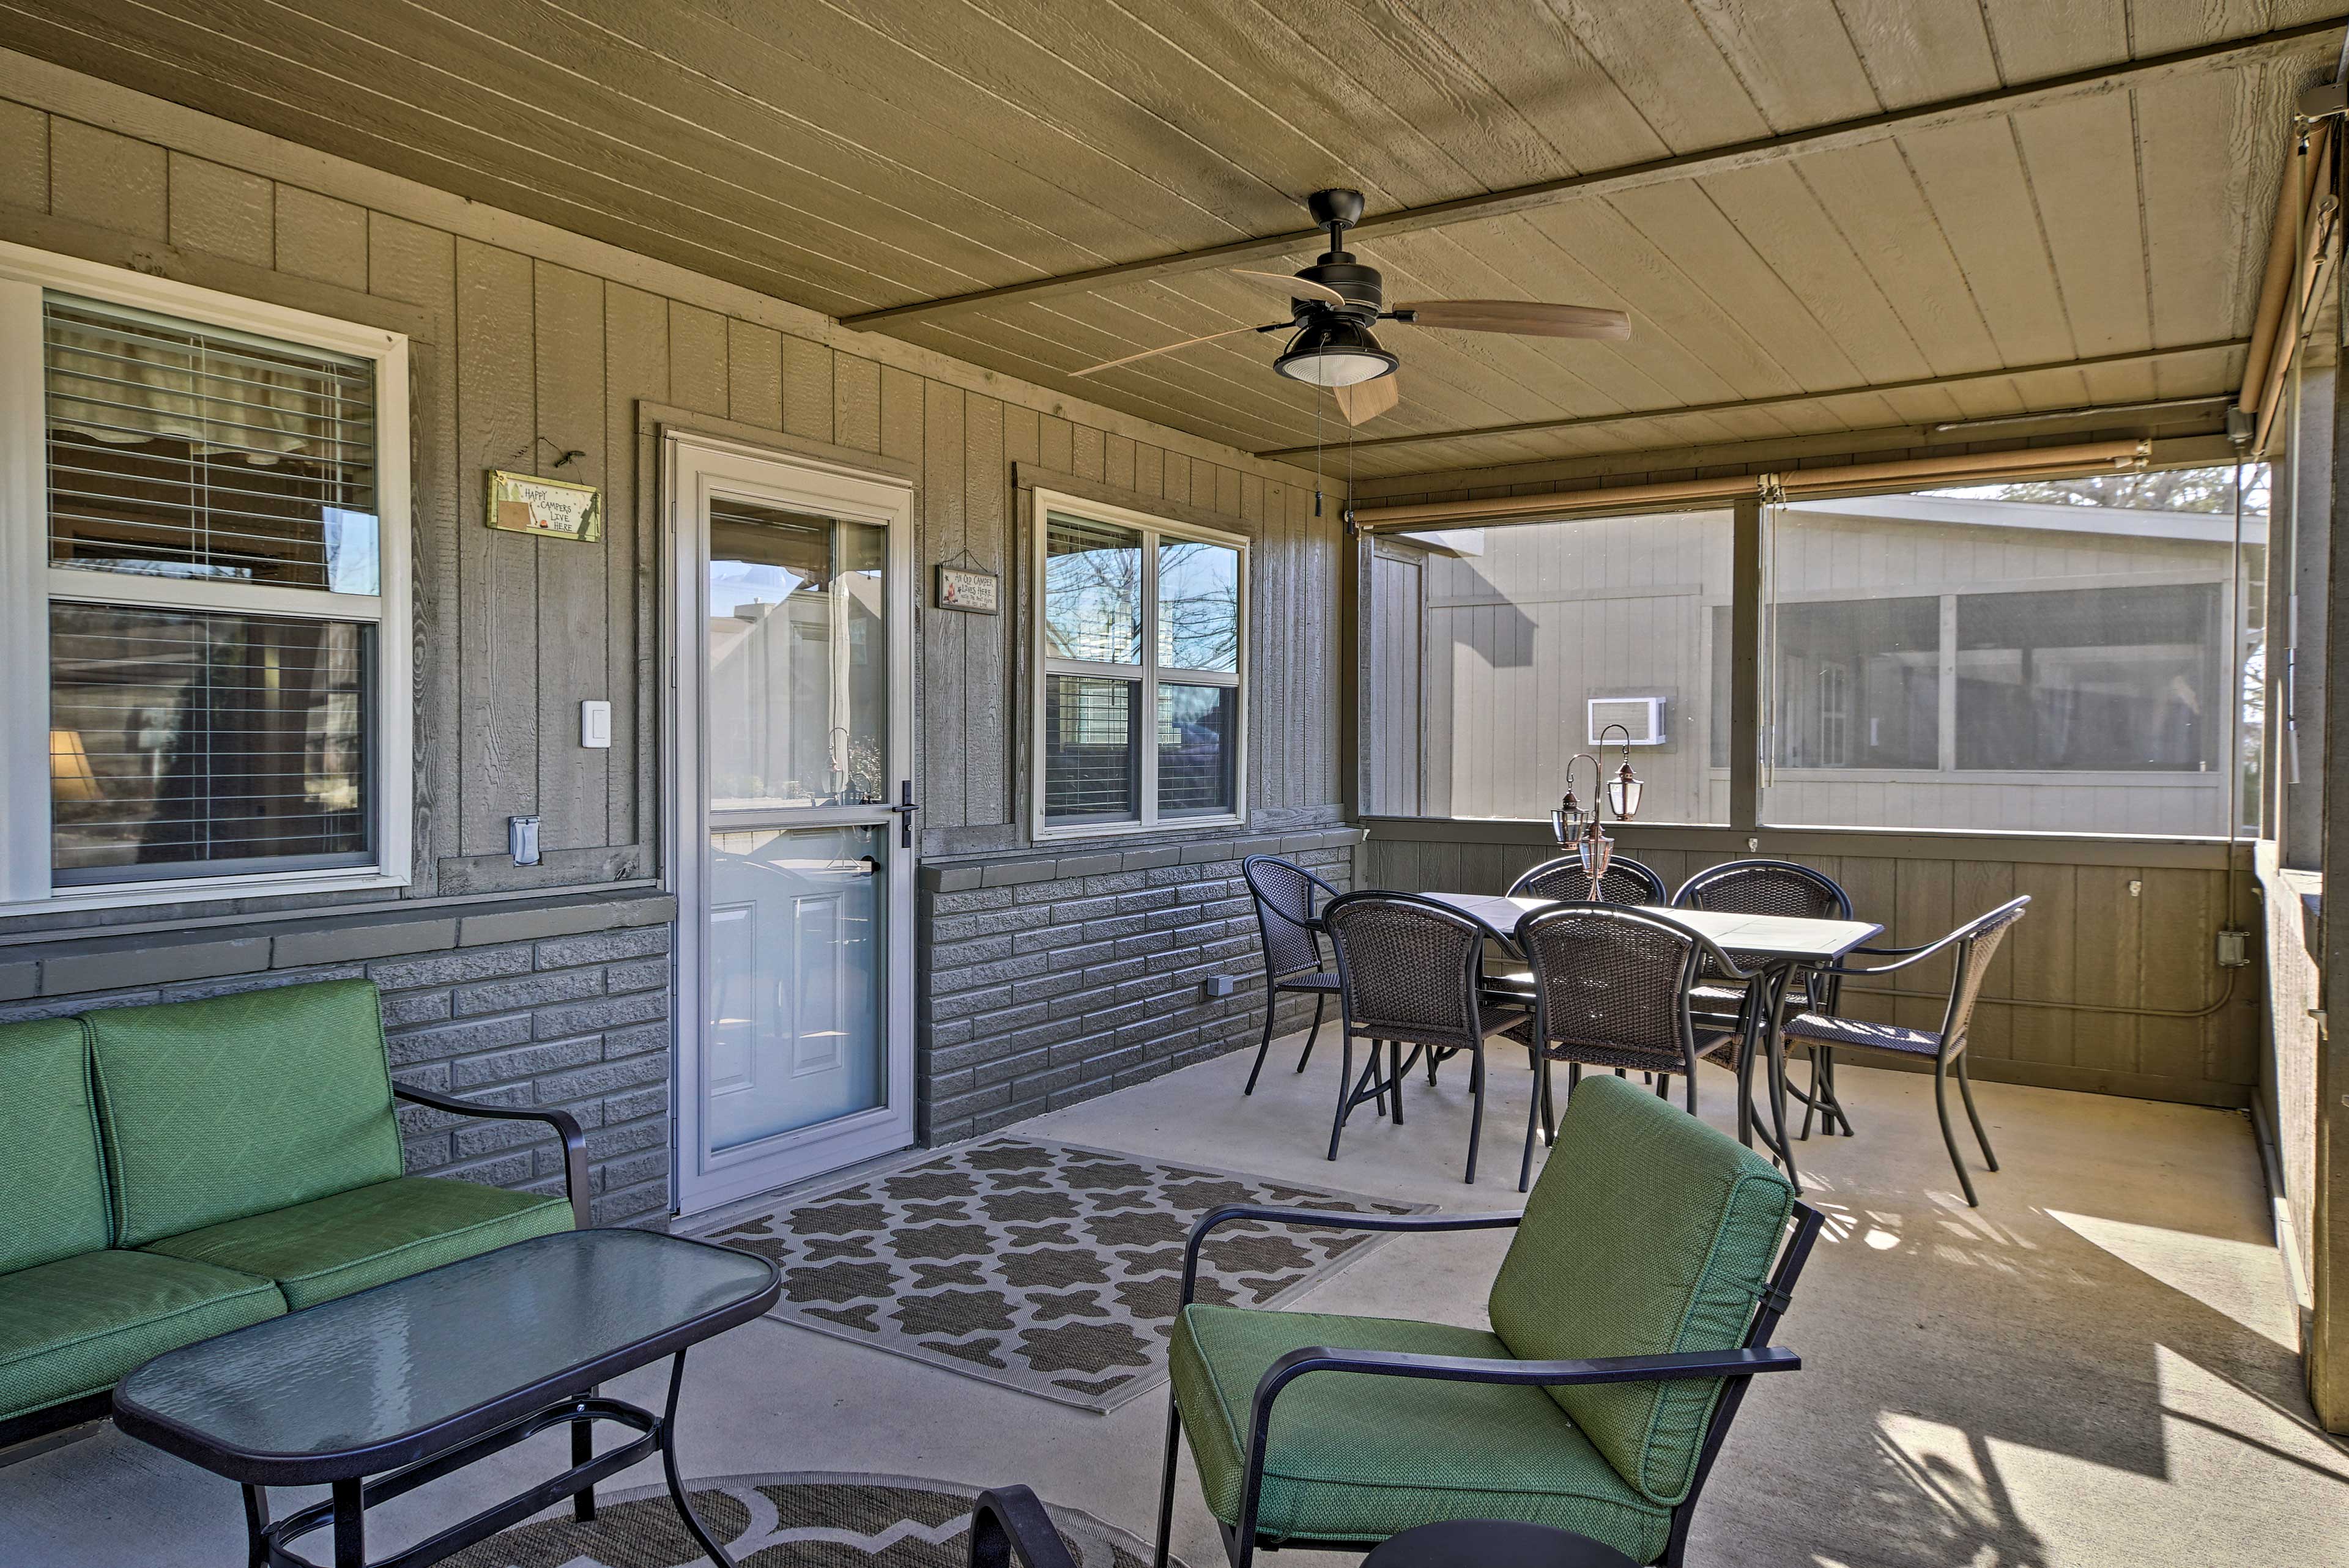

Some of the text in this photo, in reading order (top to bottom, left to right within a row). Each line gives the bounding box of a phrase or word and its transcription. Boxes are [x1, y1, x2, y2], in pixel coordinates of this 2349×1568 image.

[525, 489, 547, 502] HAPPY
[541, 501, 571, 513] CAMPERS
[551, 511, 570, 522] LIVE
[554, 522, 573, 532] HERE
[962, 584, 976, 595] LIVES
